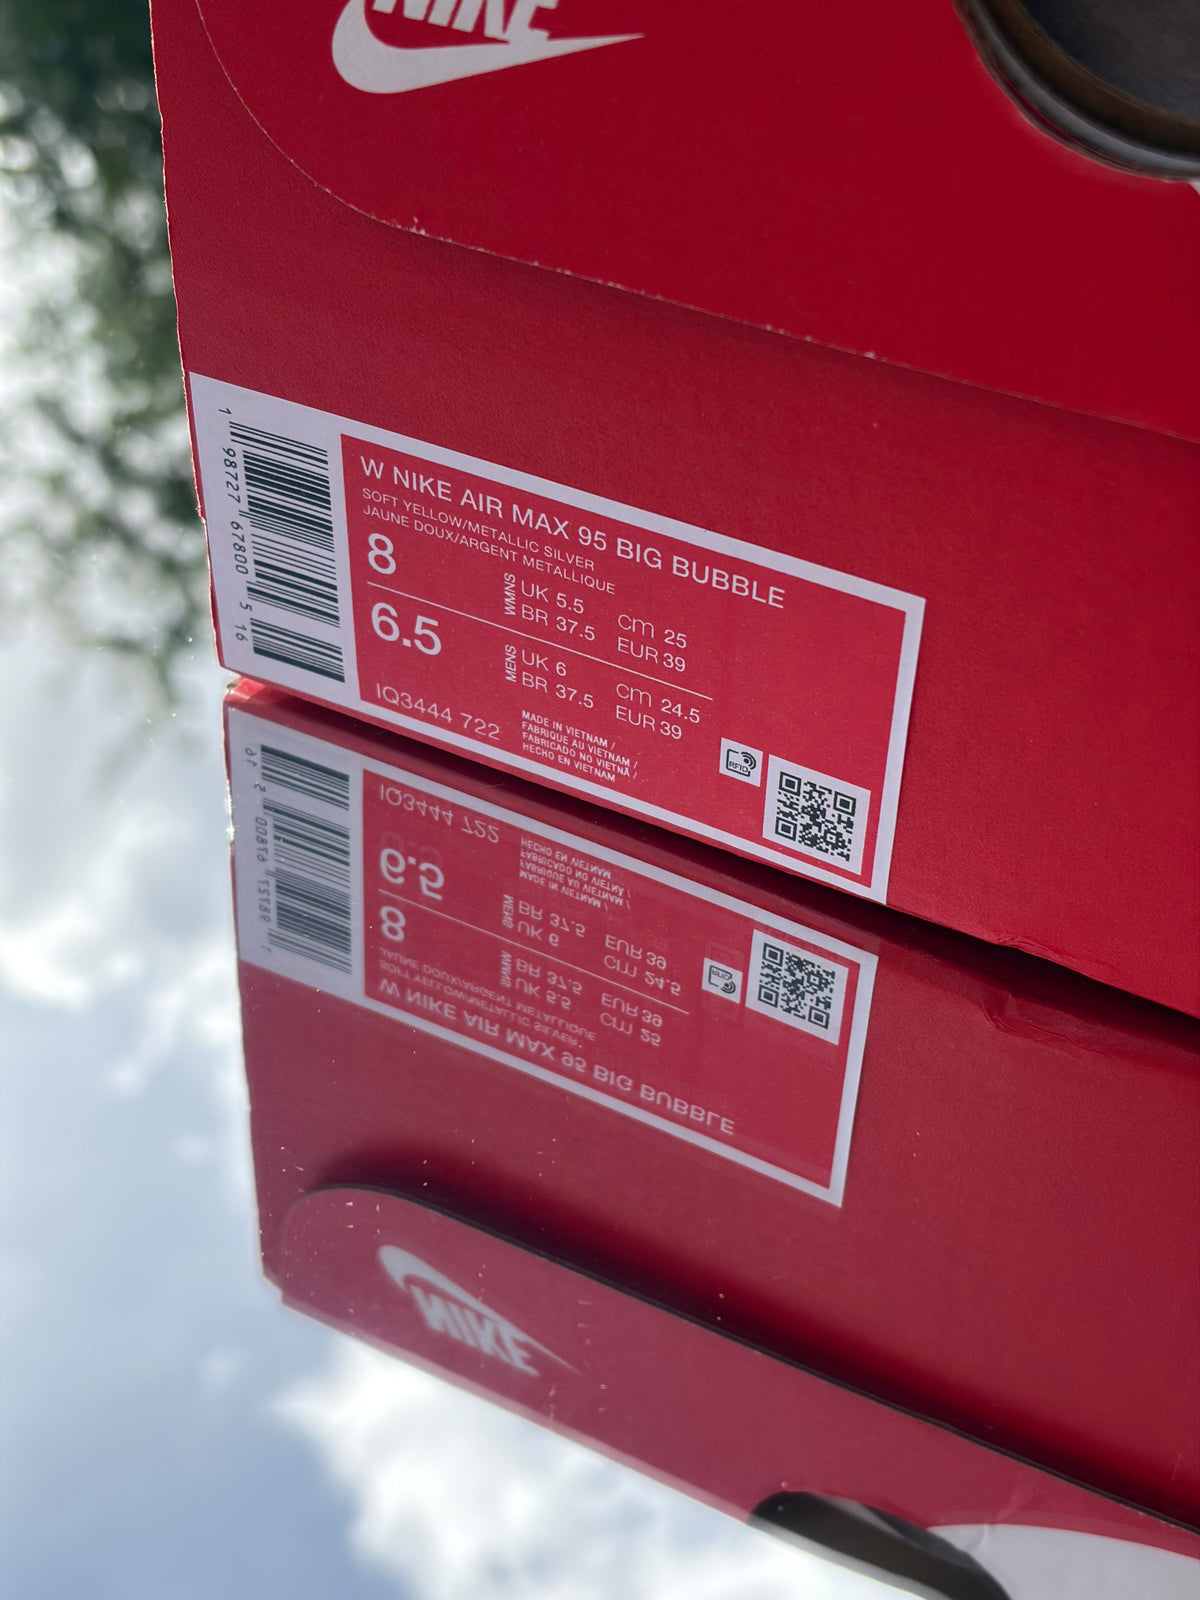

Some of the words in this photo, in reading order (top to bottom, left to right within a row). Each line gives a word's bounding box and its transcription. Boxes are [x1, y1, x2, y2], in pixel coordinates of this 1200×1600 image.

[222, 447, 241, 504] 98727
[230, 521, 249, 575] 67800
[360, 455, 384, 480] W
[393, 466, 452, 502] NIKE
[460, 489, 503, 519] AIR
[512, 504, 569, 540] MAX
[578, 526, 607, 551] 95
[616, 537, 662, 569] BIG
[672, 555, 786, 609] BUBBLE
[362, 488, 398, 507] SOFT
[403, 499, 539, 553] YELLOW/METALLIC
[544, 545, 595, 572] SILVER
[363, 505, 409, 527] JAUNE
[414, 520, 518, 562] DOUX/ARGENT
[522, 555, 616, 595] METALLIQUE
[367, 533, 397, 575] 8
[240, 601, 253, 612] 5
[504, 572, 516, 616] WMNS
[521, 580, 549, 603] UK
[556, 592, 584, 614] 5.5
[235, 624, 249, 642] 16
[371, 602, 442, 656] 6.5
[521, 603, 548, 626] BR
[556, 616, 595, 641] 37.5
[664, 629, 687, 649] 25
[504, 645, 517, 683] MENS
[521, 649, 549, 671] UK
[556, 662, 567, 677] 6
[618, 637, 658, 664] EUR
[663, 652, 686, 672] 39
[521, 671, 548, 693] BR
[555, 684, 594, 709] 37.5
[376, 682, 452, 723] IQ3444
[460, 712, 500, 740] 722
[522, 710, 549, 727] MADE
[553, 721, 562, 731] IN
[565, 725, 608, 747] VIETNAM
[616, 705, 655, 731] EUR
[659, 721, 682, 740] 39
[660, 698, 700, 724] 24.5
[522, 721, 568, 745] FABRIQUE
[572, 739, 585, 750] AU
[588, 744, 630, 767] VIETNAM
[522, 732, 576, 757] FABRICADO
[580, 752, 592, 763] NO
[522, 743, 554, 760] HECHO
[558, 755, 570, 766] EN
[574, 761, 616, 782] VIETNAM
[729, 760, 749, 773] RFID
